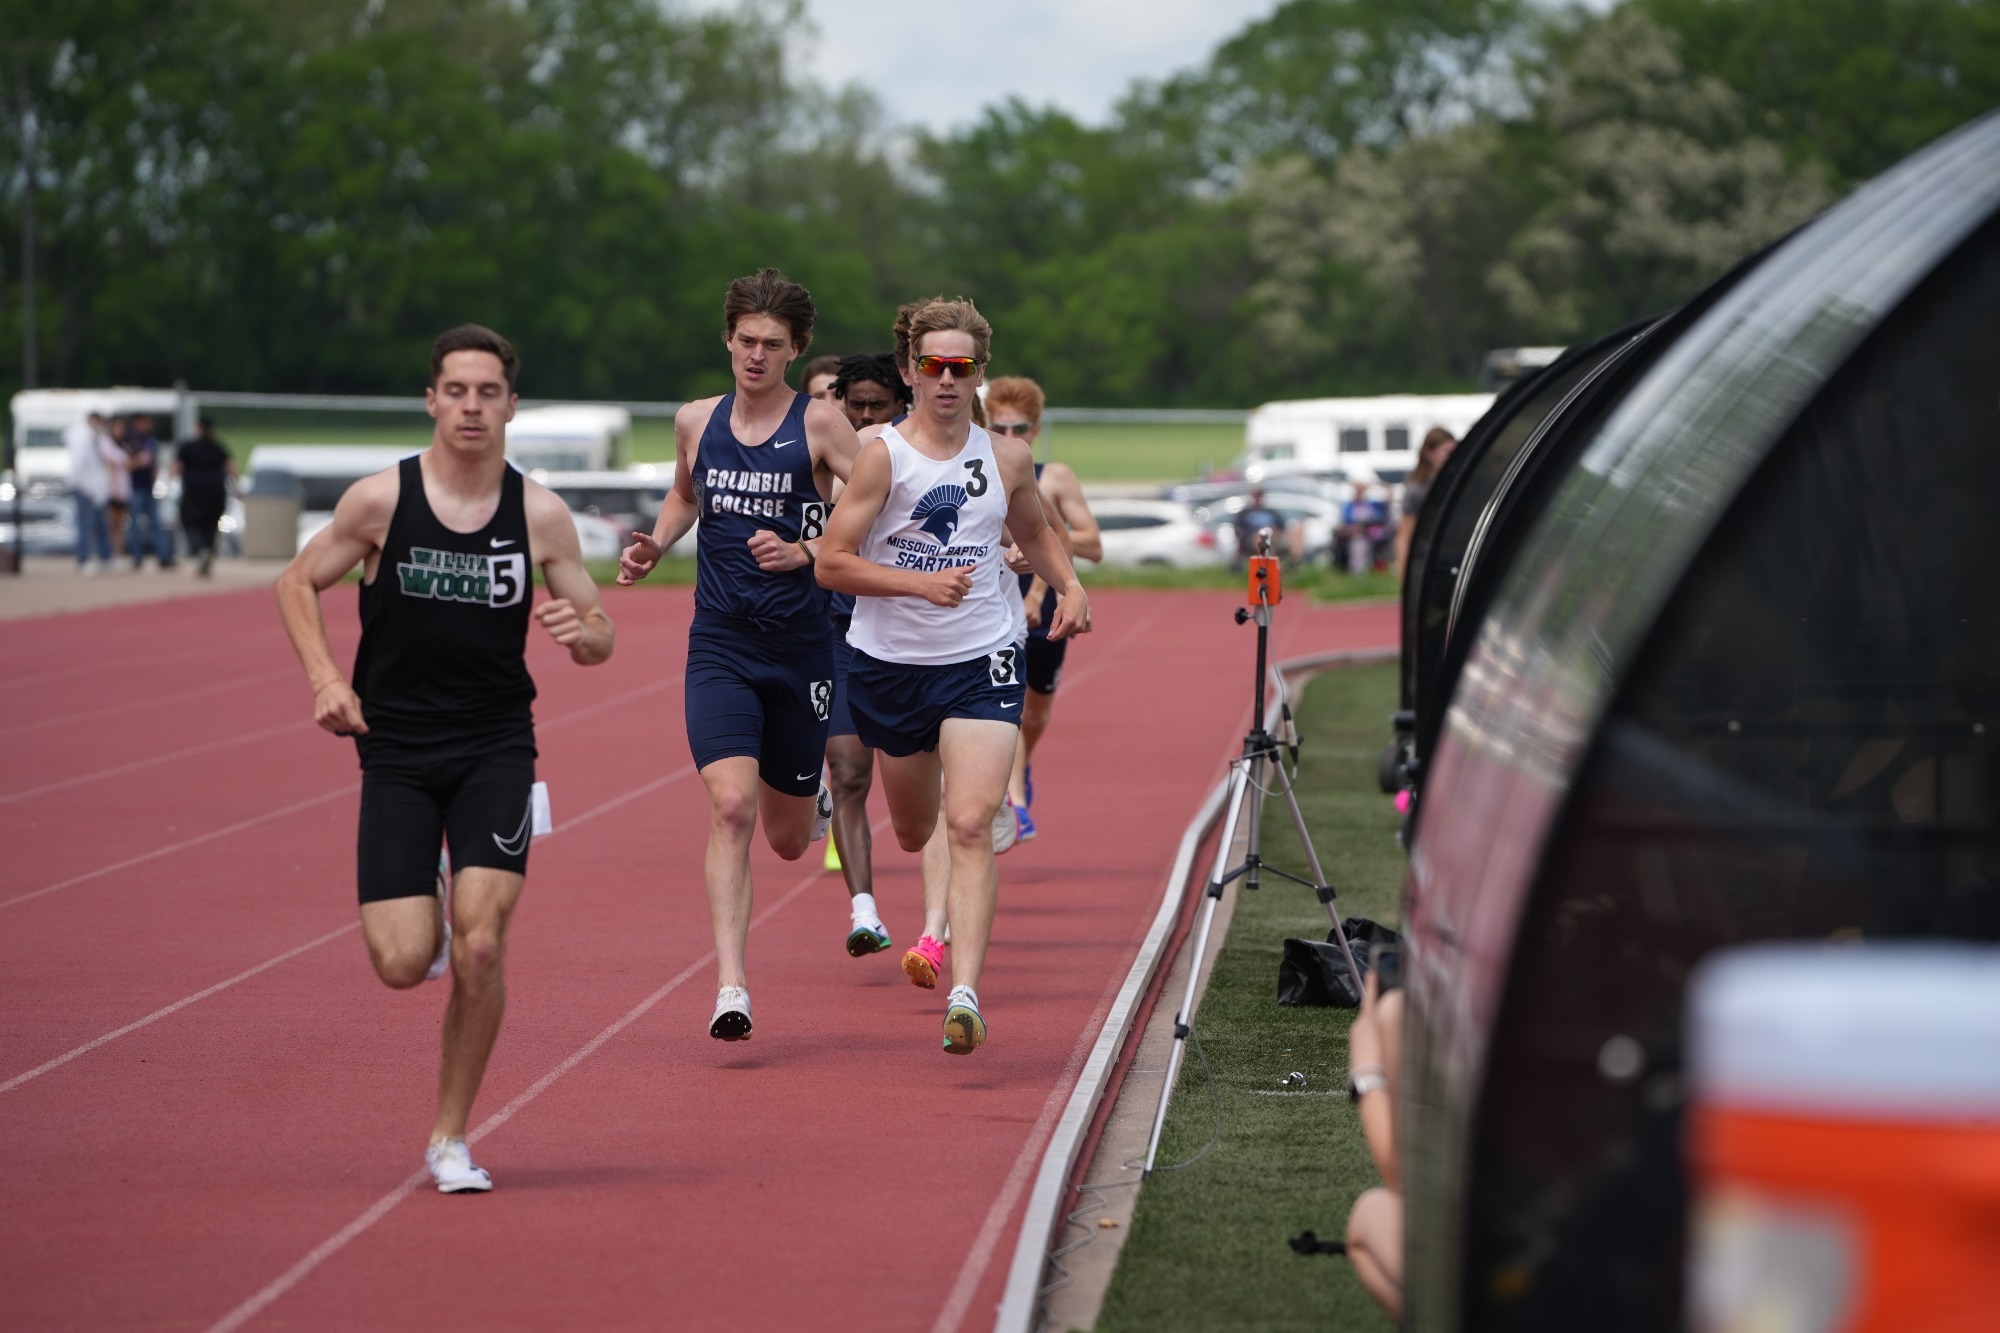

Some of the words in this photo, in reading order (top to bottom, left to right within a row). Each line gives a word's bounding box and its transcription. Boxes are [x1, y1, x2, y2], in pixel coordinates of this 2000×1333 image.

[706, 468, 793, 493] COLUMBIA
[964, 458, 988, 498] 3
[711, 494, 786, 518] COLLEGE
[801, 503, 824, 542] 8
[409, 546, 490, 573] WILLIA
[886, 535, 941, 556] MISSOURI
[945, 545, 989, 557] BAPTIST
[396, 561, 490, 605] WOOD
[493, 559, 517, 605] 5
[991, 649, 1015, 684] 3
[814, 680, 831, 720] 8
